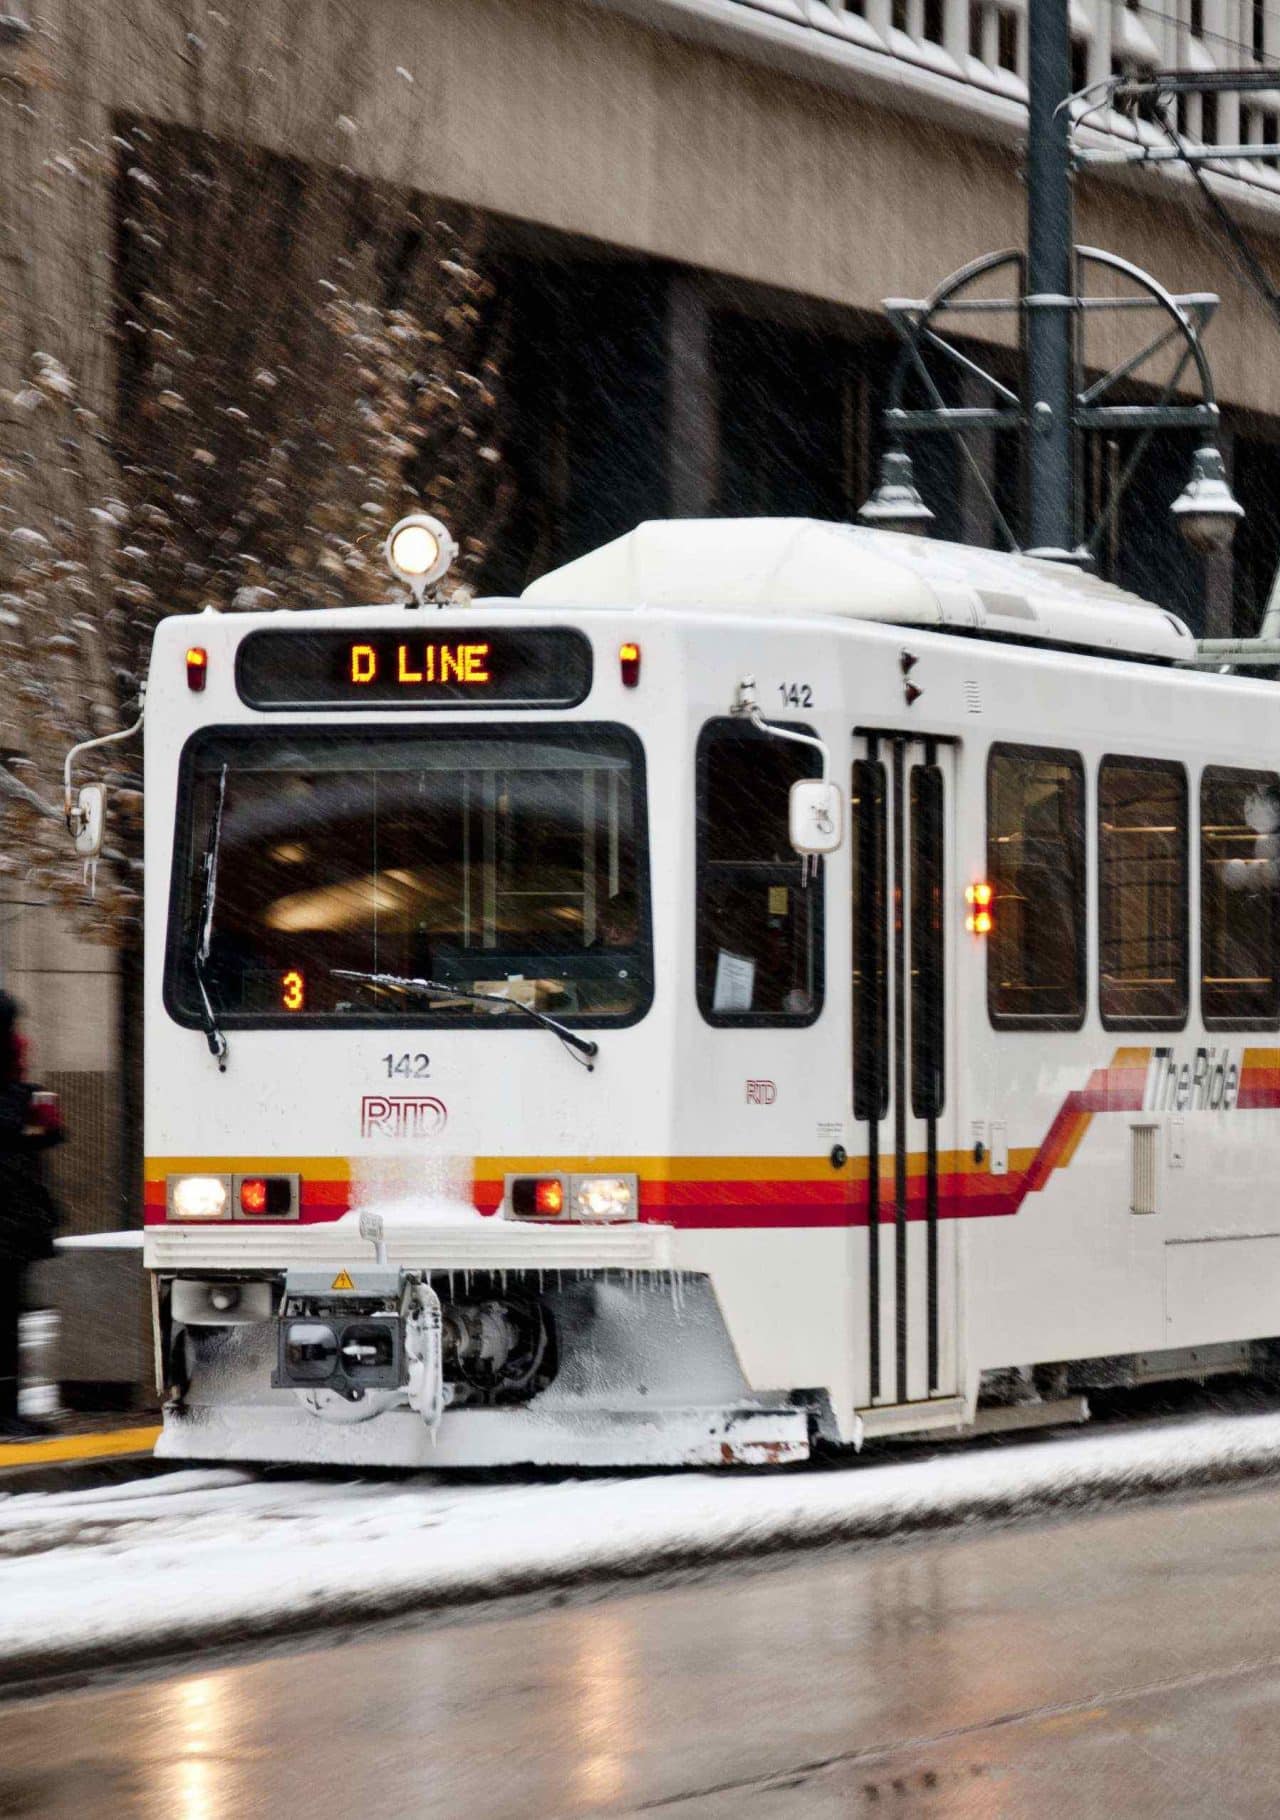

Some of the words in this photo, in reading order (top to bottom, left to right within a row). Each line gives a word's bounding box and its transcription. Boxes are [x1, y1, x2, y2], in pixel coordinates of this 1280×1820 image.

[351, 644, 376, 683] D
[398, 644, 489, 683] LINE
[778, 682, 814, 708] 142
[282, 971, 304, 1010] 3
[381, 1053, 431, 1079] 142
[746, 1079, 777, 1105] RTD
[361, 1096, 448, 1139] RTD
